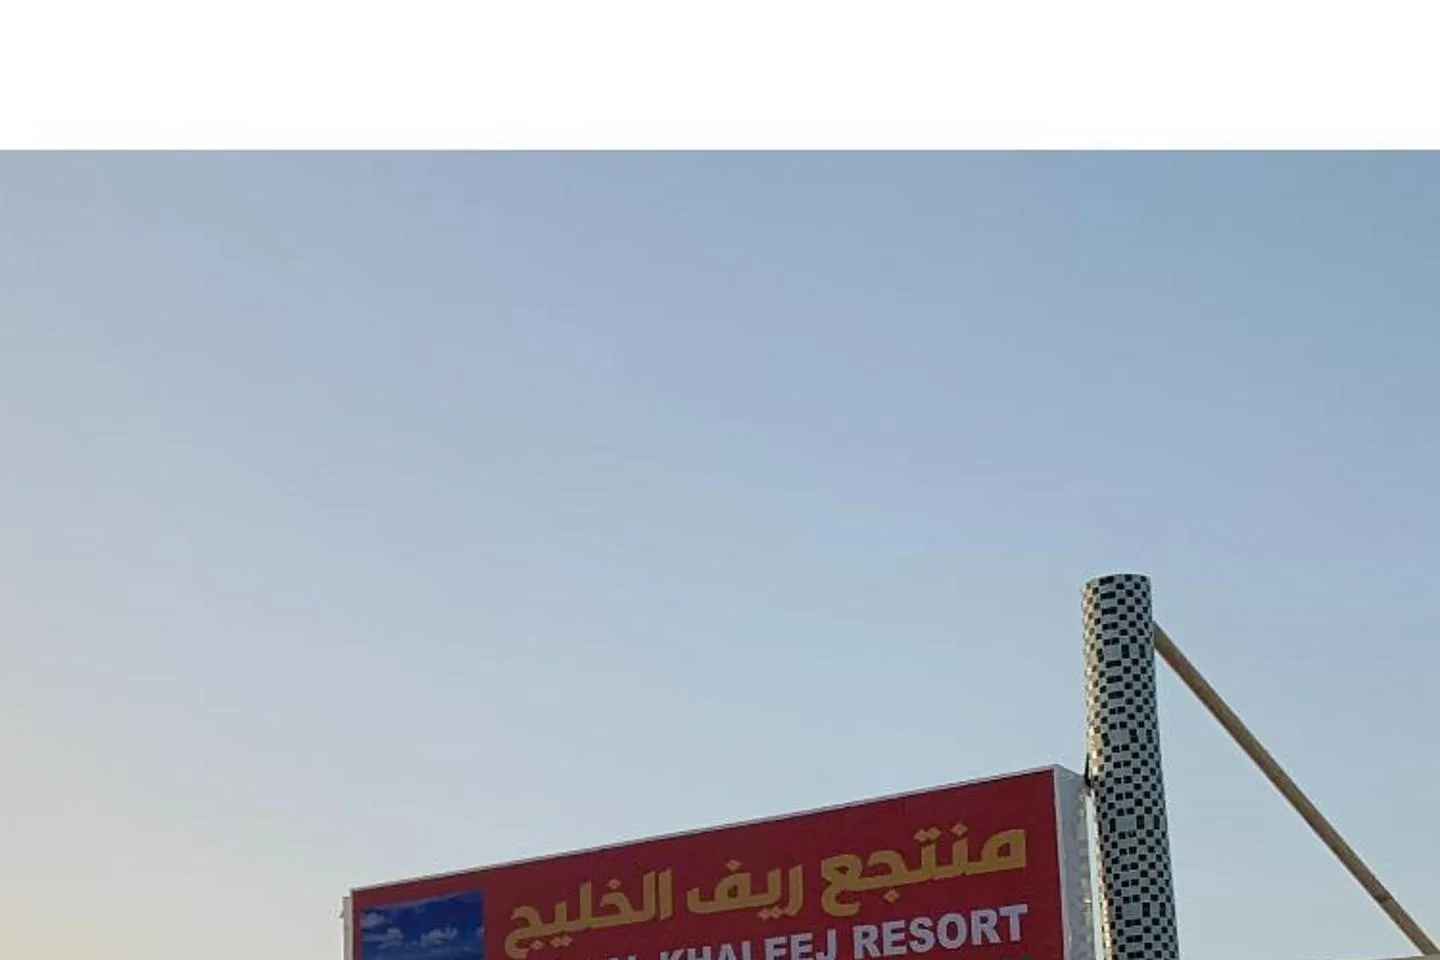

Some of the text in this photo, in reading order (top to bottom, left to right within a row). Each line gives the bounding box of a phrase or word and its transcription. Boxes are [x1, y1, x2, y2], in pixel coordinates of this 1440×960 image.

[504, 823, 1028, 958] منتجع ريف الخليج
[853, 904, 1028, 960] RESORT
